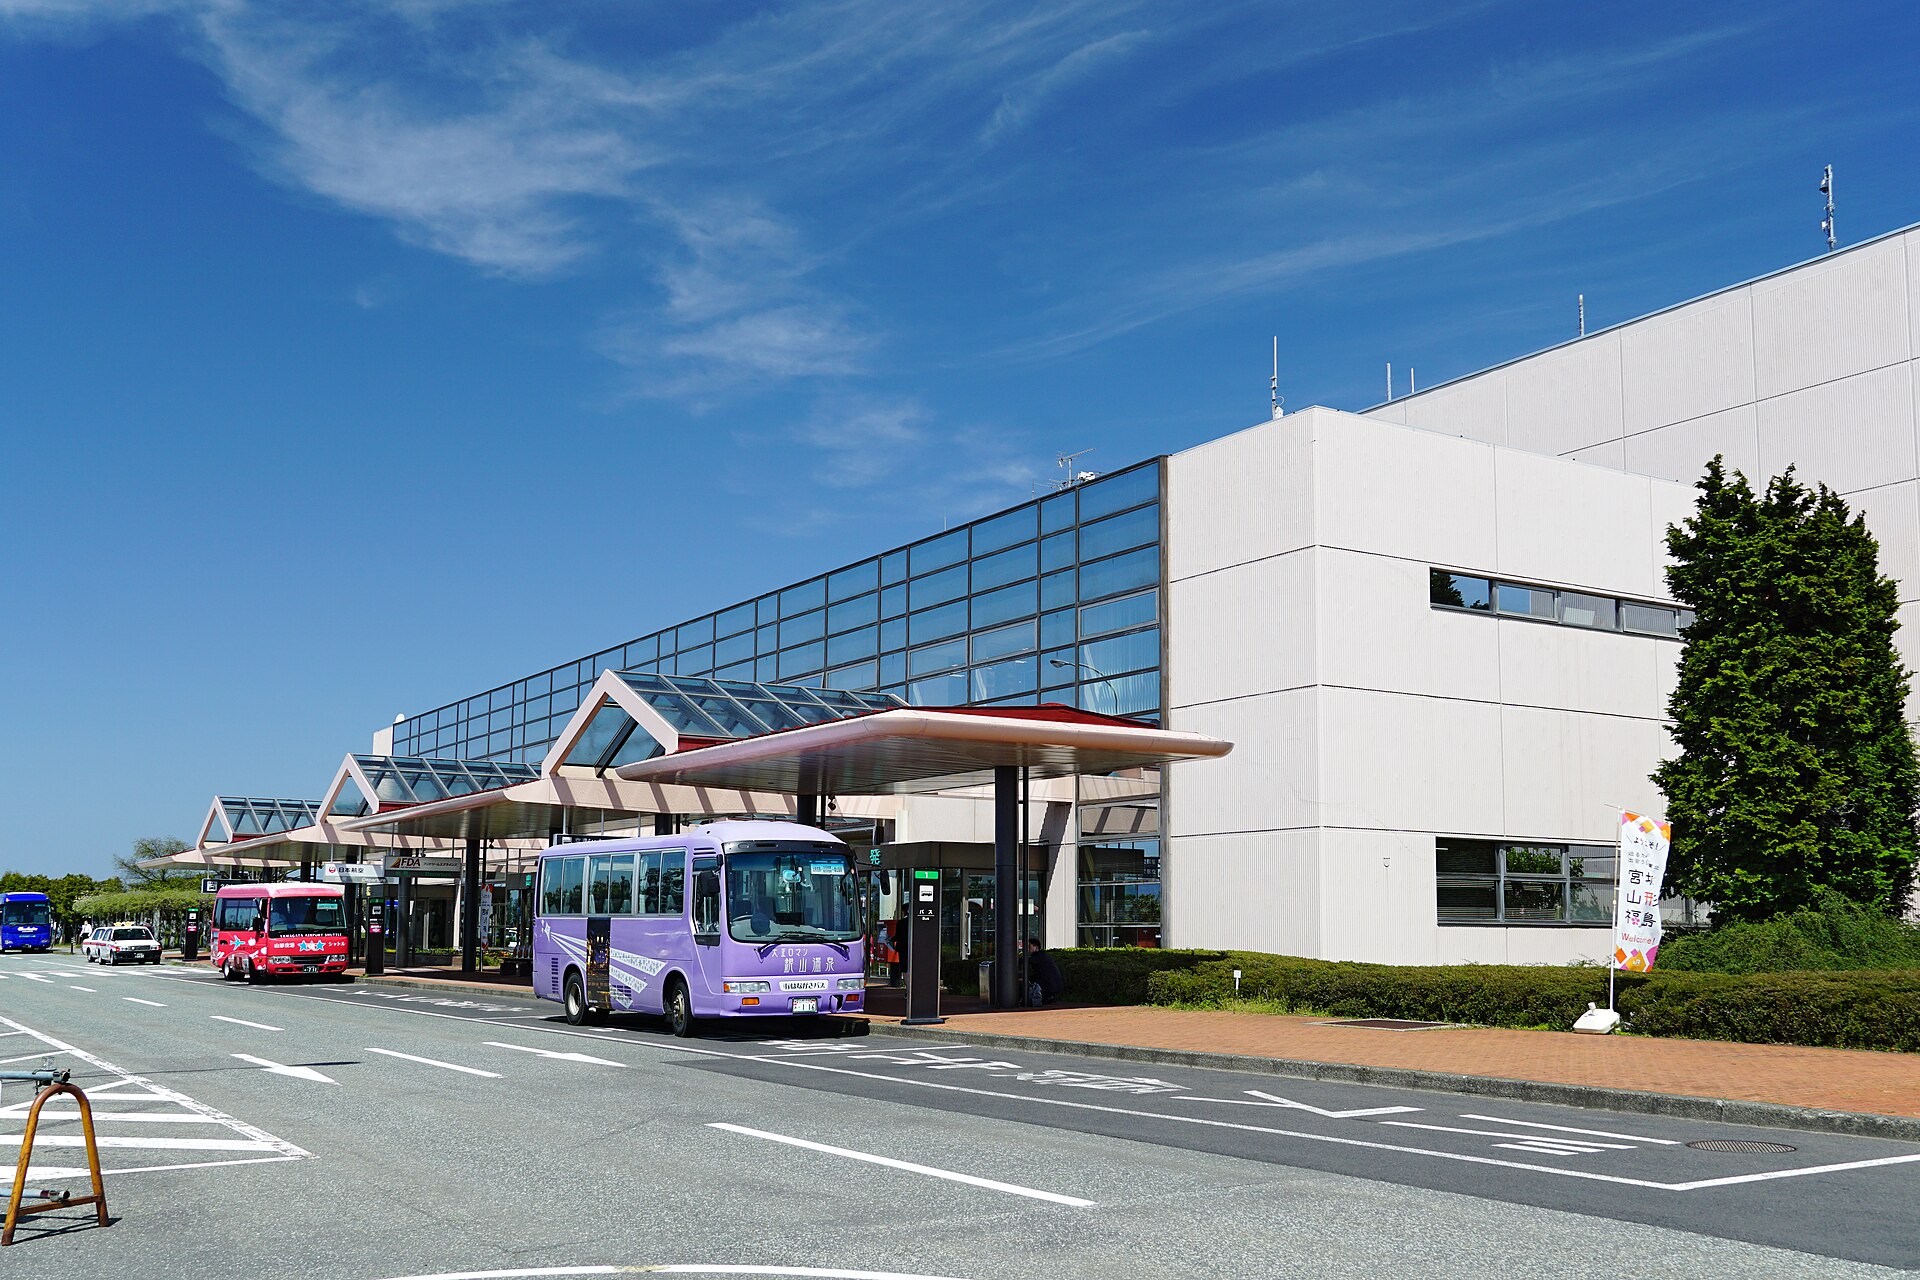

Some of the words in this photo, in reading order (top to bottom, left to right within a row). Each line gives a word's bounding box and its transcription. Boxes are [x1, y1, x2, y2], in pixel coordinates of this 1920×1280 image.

[401, 857, 421, 868] FDA
[338, 866, 365, 875] 日本航空
